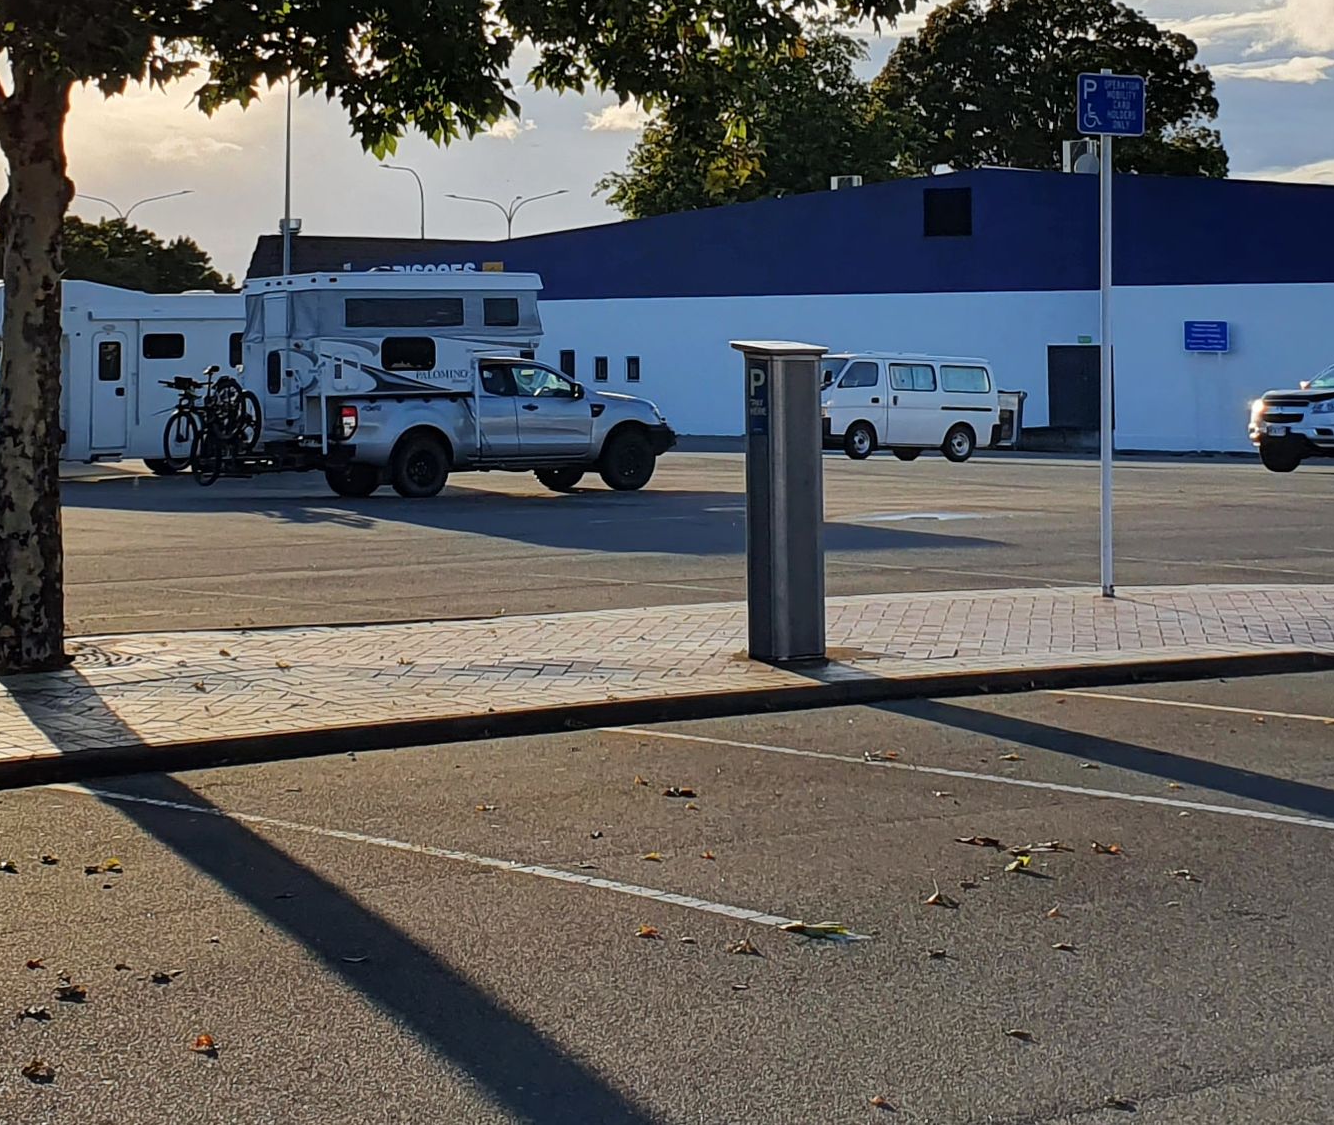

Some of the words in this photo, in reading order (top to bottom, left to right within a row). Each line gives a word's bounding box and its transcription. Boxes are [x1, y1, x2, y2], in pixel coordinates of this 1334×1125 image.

[1084, 79, 1097, 100] P
[1104, 79, 1140, 90] OPERATION
[1107, 90, 1136, 100] MOBILITY
[1107, 110, 1136, 121] HOLDERS
[415, 369, 469, 380] PALOMINO
[750, 368, 766, 396] P
